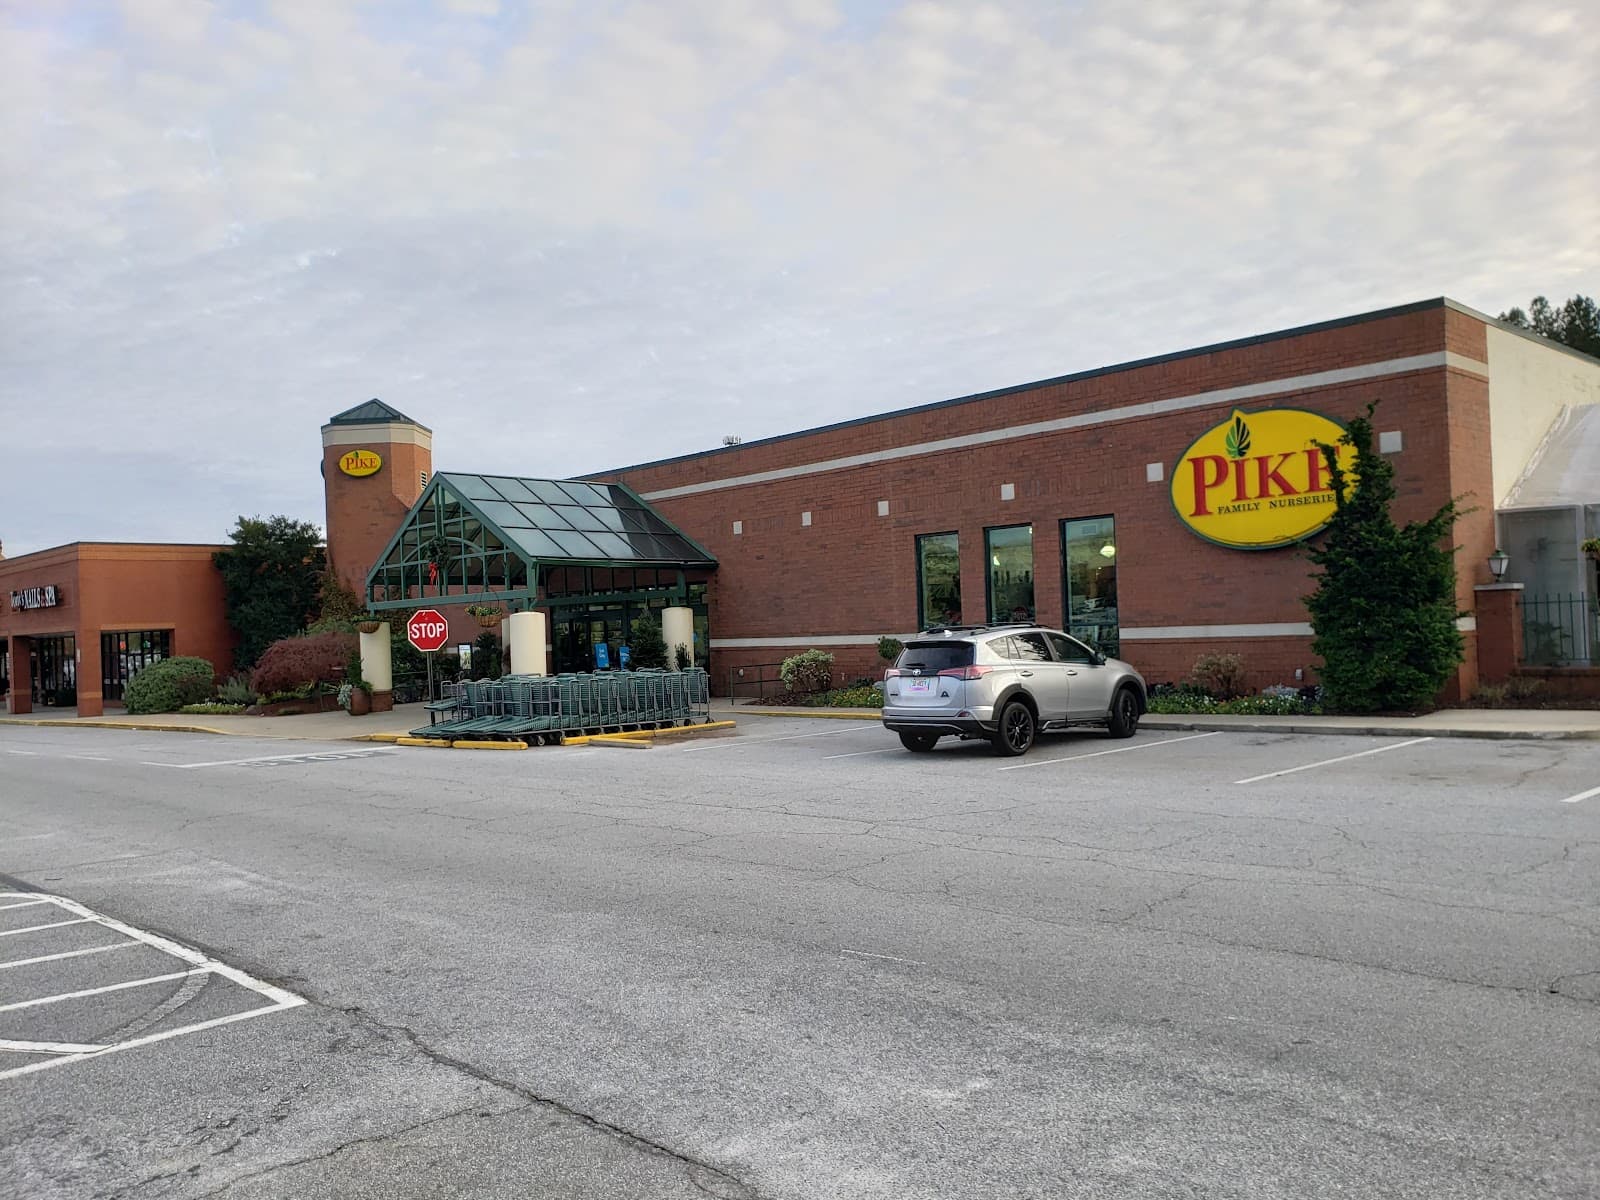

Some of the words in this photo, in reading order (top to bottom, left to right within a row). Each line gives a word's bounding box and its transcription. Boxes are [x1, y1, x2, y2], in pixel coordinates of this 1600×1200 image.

[345, 457, 377, 470] PIKE
[1187, 445, 1341, 517] PIKE
[1217, 501, 1262, 515] FAMILY
[1269, 493, 1337, 509] NURSERIE
[24, 587, 41, 609] NAILS
[45, 585, 56, 607] SPA
[411, 622, 446, 639] STOP
